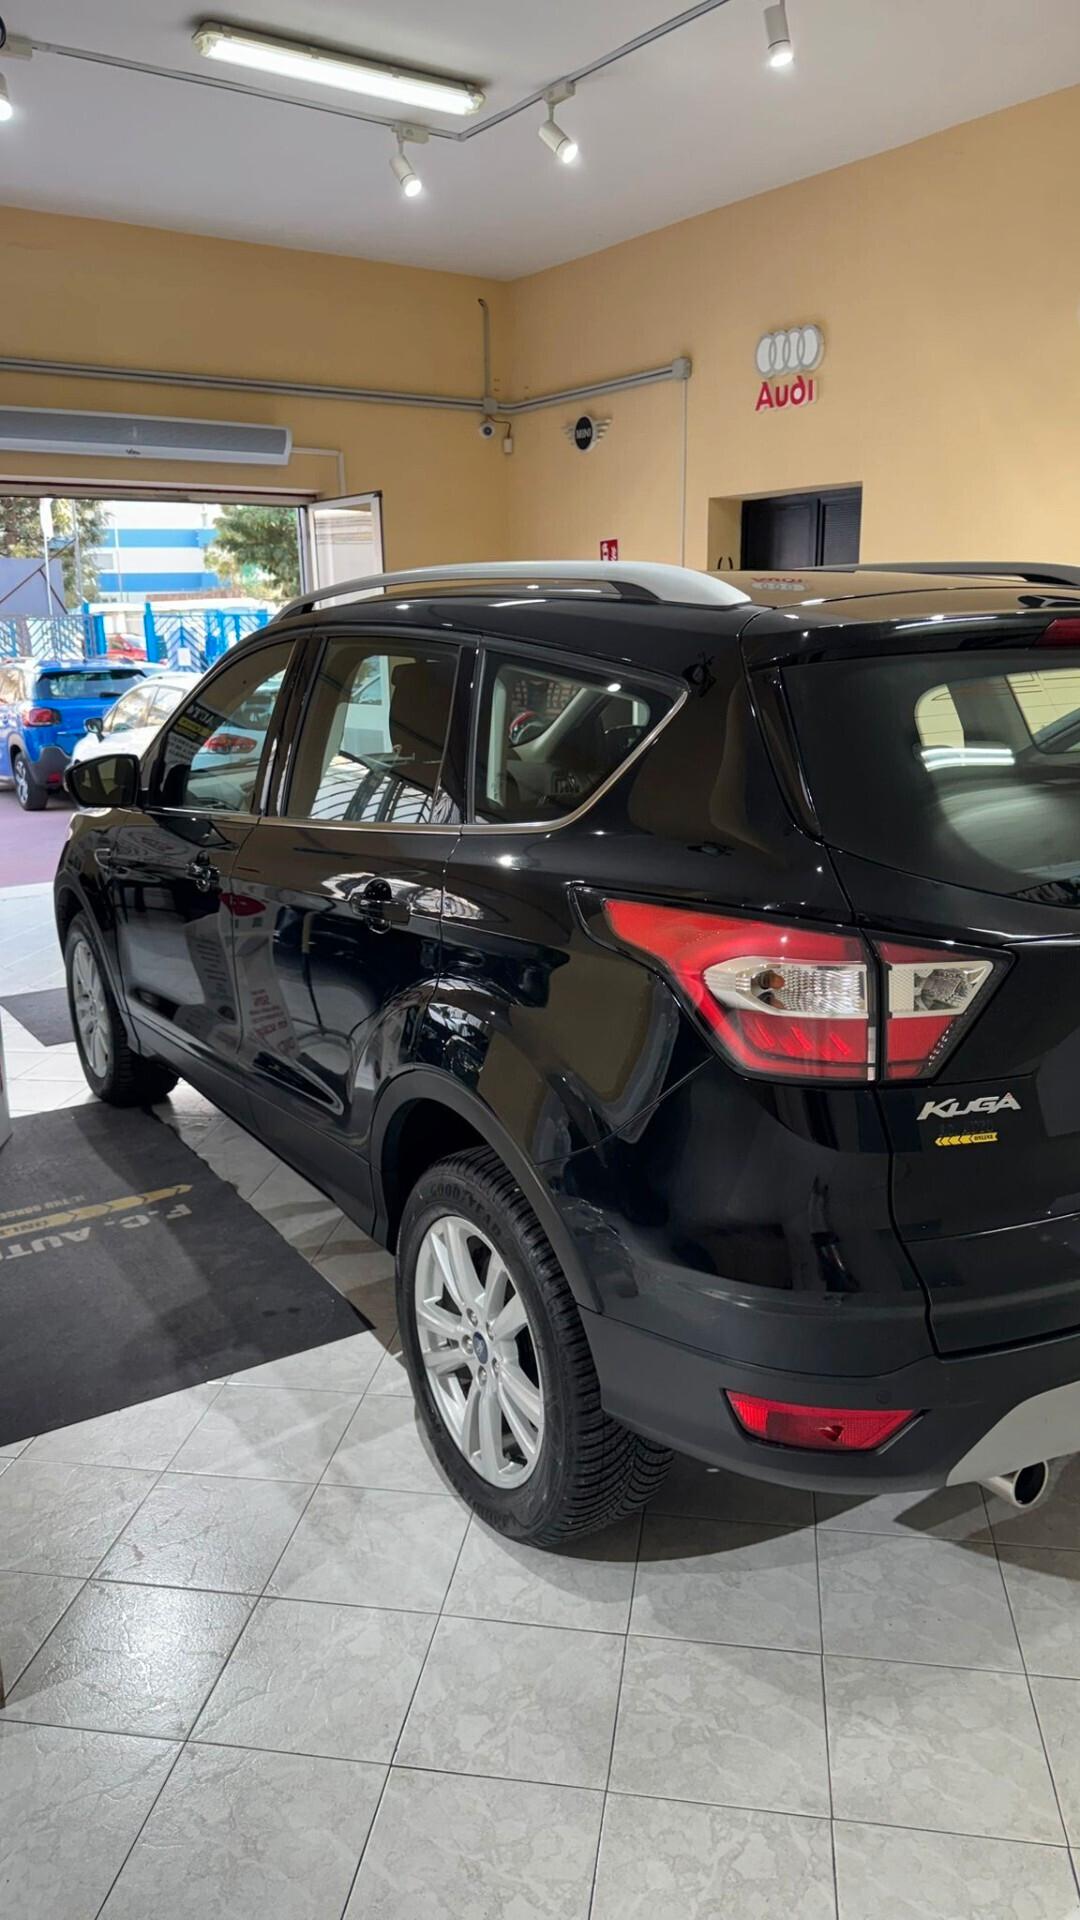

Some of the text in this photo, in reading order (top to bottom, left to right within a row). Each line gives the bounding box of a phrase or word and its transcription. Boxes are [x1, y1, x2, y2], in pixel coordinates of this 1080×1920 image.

[755, 375, 813, 411] Audi
[916, 1092, 1021, 1120] KUGA
[0, 1226, 91, 1260] AUT
